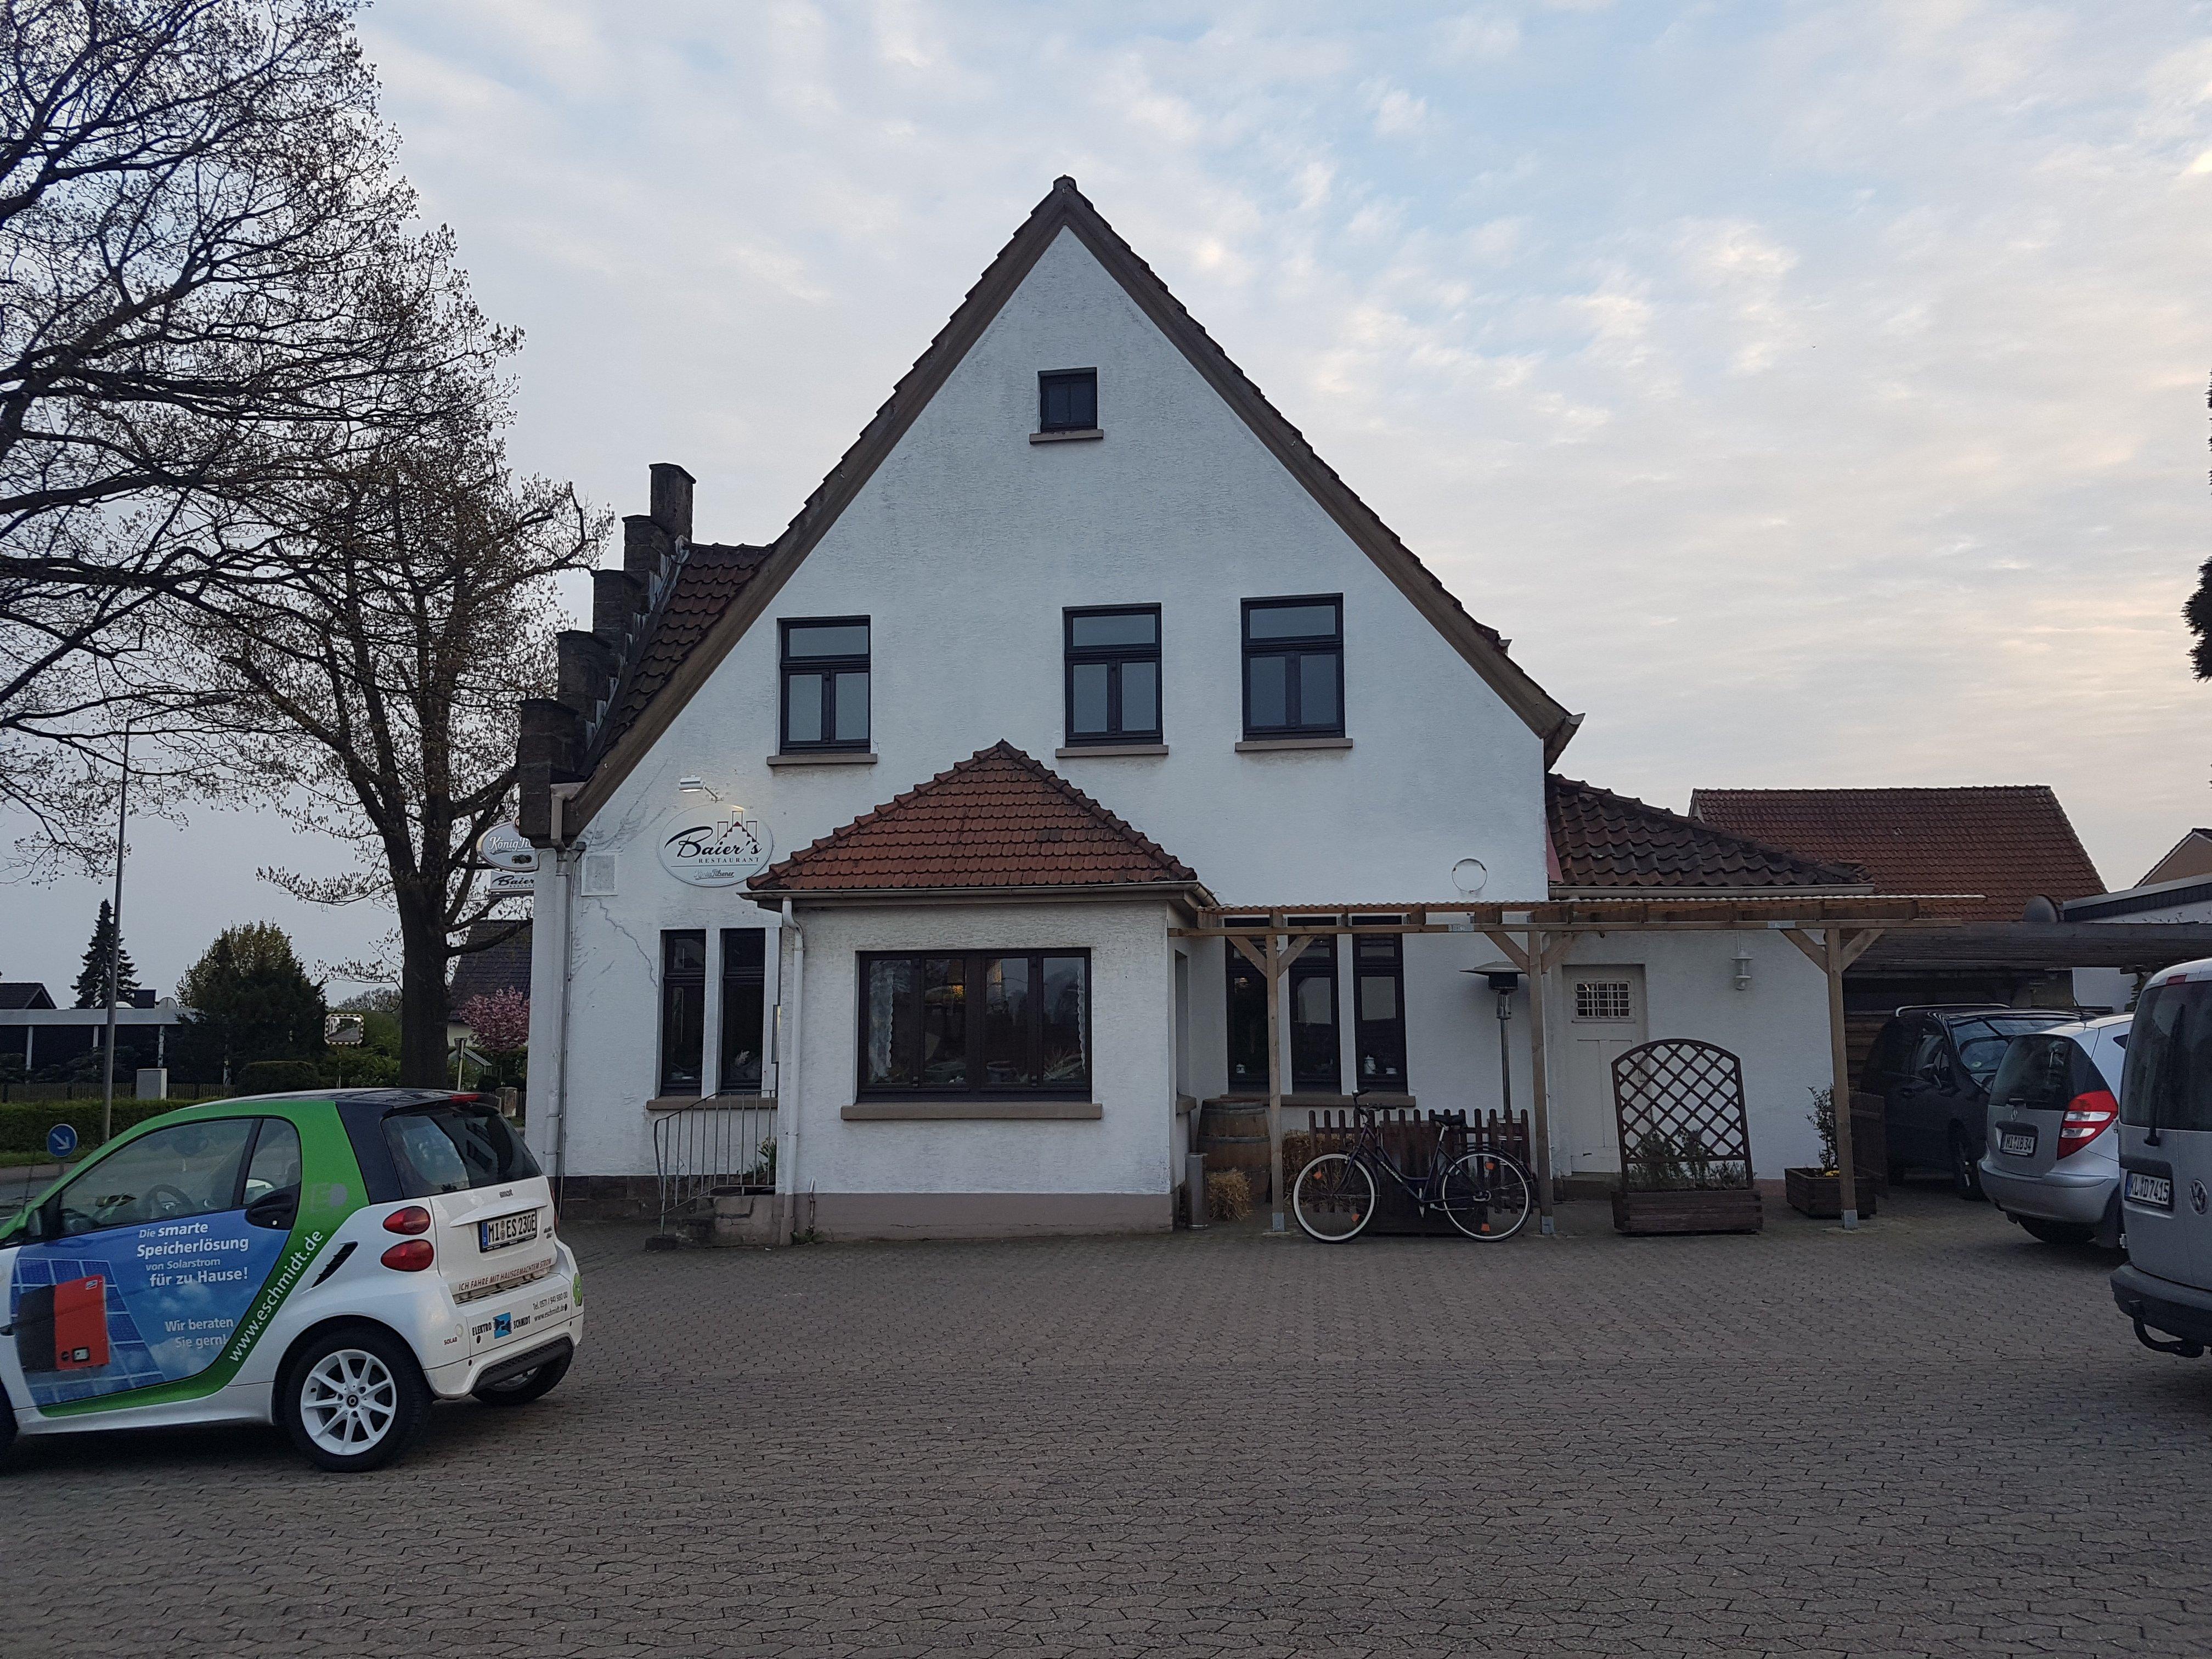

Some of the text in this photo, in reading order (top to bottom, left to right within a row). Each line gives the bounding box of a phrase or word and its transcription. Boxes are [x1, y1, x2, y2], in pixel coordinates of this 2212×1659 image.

[664, 826, 762, 857] Baier's
[139, 1222, 208, 1238] Die smarte
[488, 1223, 499, 1243] MI
[506, 1218, 516, 1238] ES
[137, 1238, 249, 1260] Speicherlösung
[145, 1259, 221, 1271] von Solarstrom
[150, 1267, 247, 1288] für zu Hause!
[459, 1282, 469, 1291] ICH
[470, 1277, 489, 1289] FAHRE
[489, 1274, 499, 1283] MIT
[229, 1231, 323, 1362] www.eschmidt.de
[165, 1318, 234, 1332] Wir beraten
[472, 1315, 531, 1336] ELEKTRO SCHMIDT
[175, 1334, 226, 1350] Sie gern!
[444, 1337, 458, 1345] SOLAR
